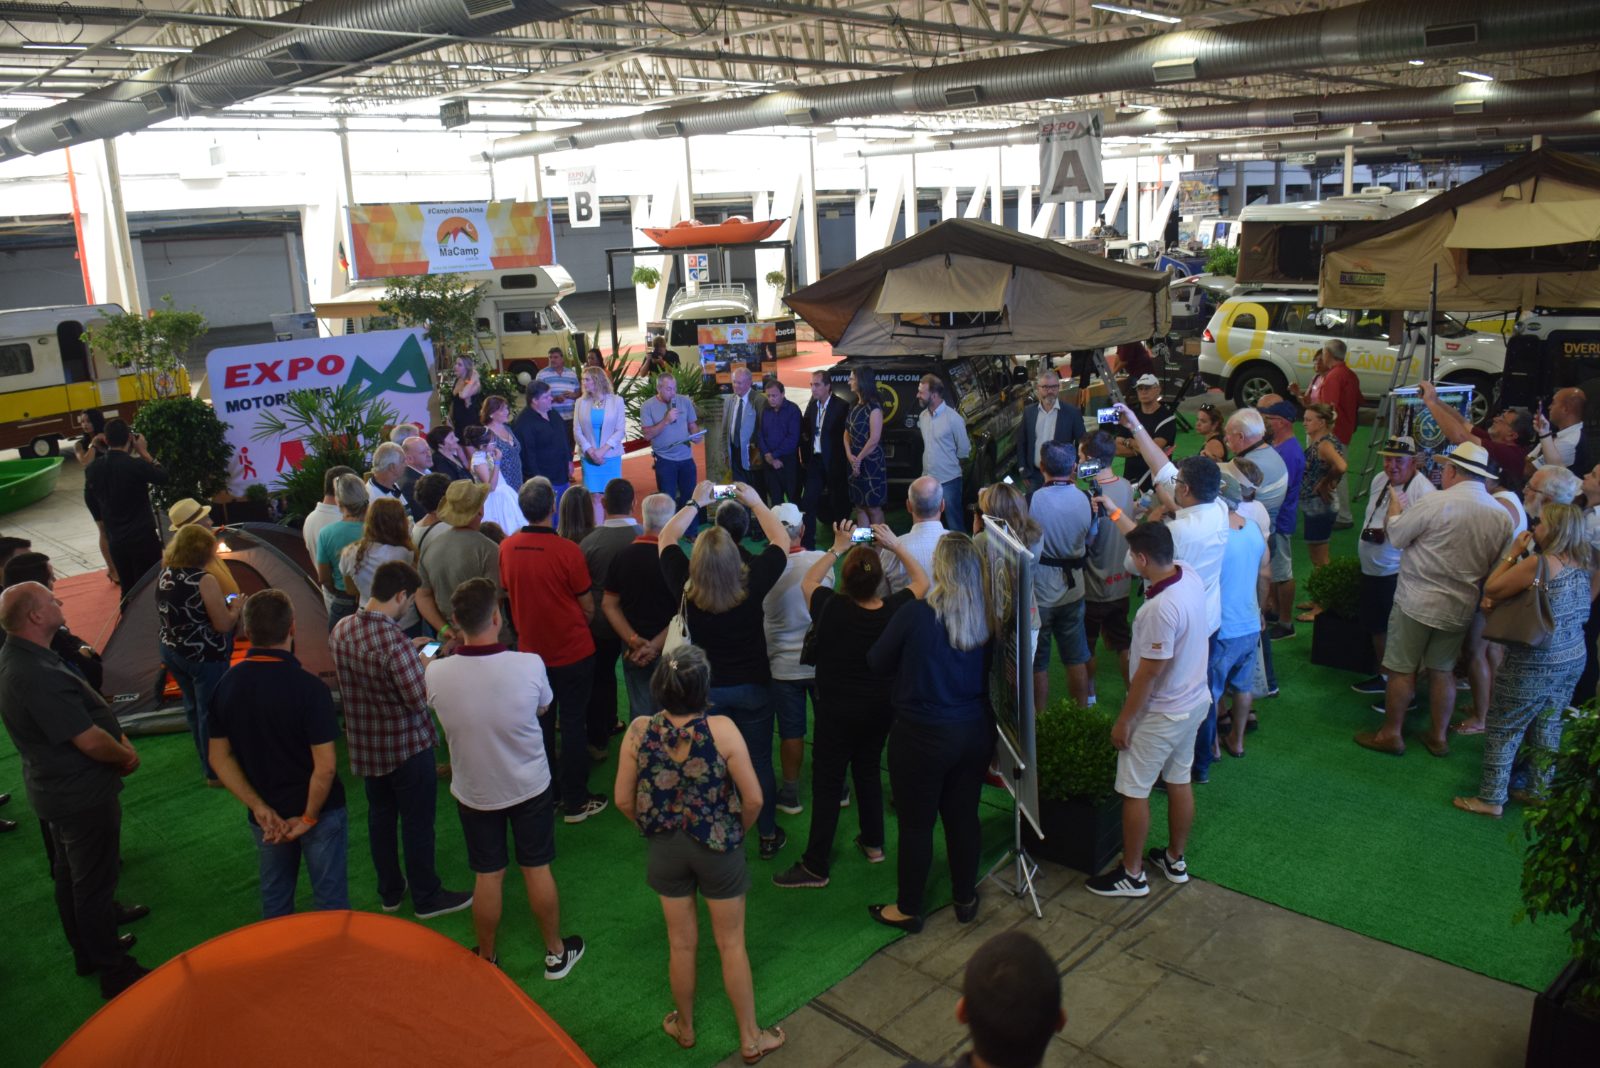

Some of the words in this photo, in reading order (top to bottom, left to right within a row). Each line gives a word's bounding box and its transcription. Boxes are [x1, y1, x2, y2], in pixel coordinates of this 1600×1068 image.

[1042, 120, 1076, 133] EXPO
[1051, 149, 1091, 195] A
[575, 191, 593, 222] B
[440, 246, 479, 257] MaCamp
[224, 354, 345, 389] EXPO
